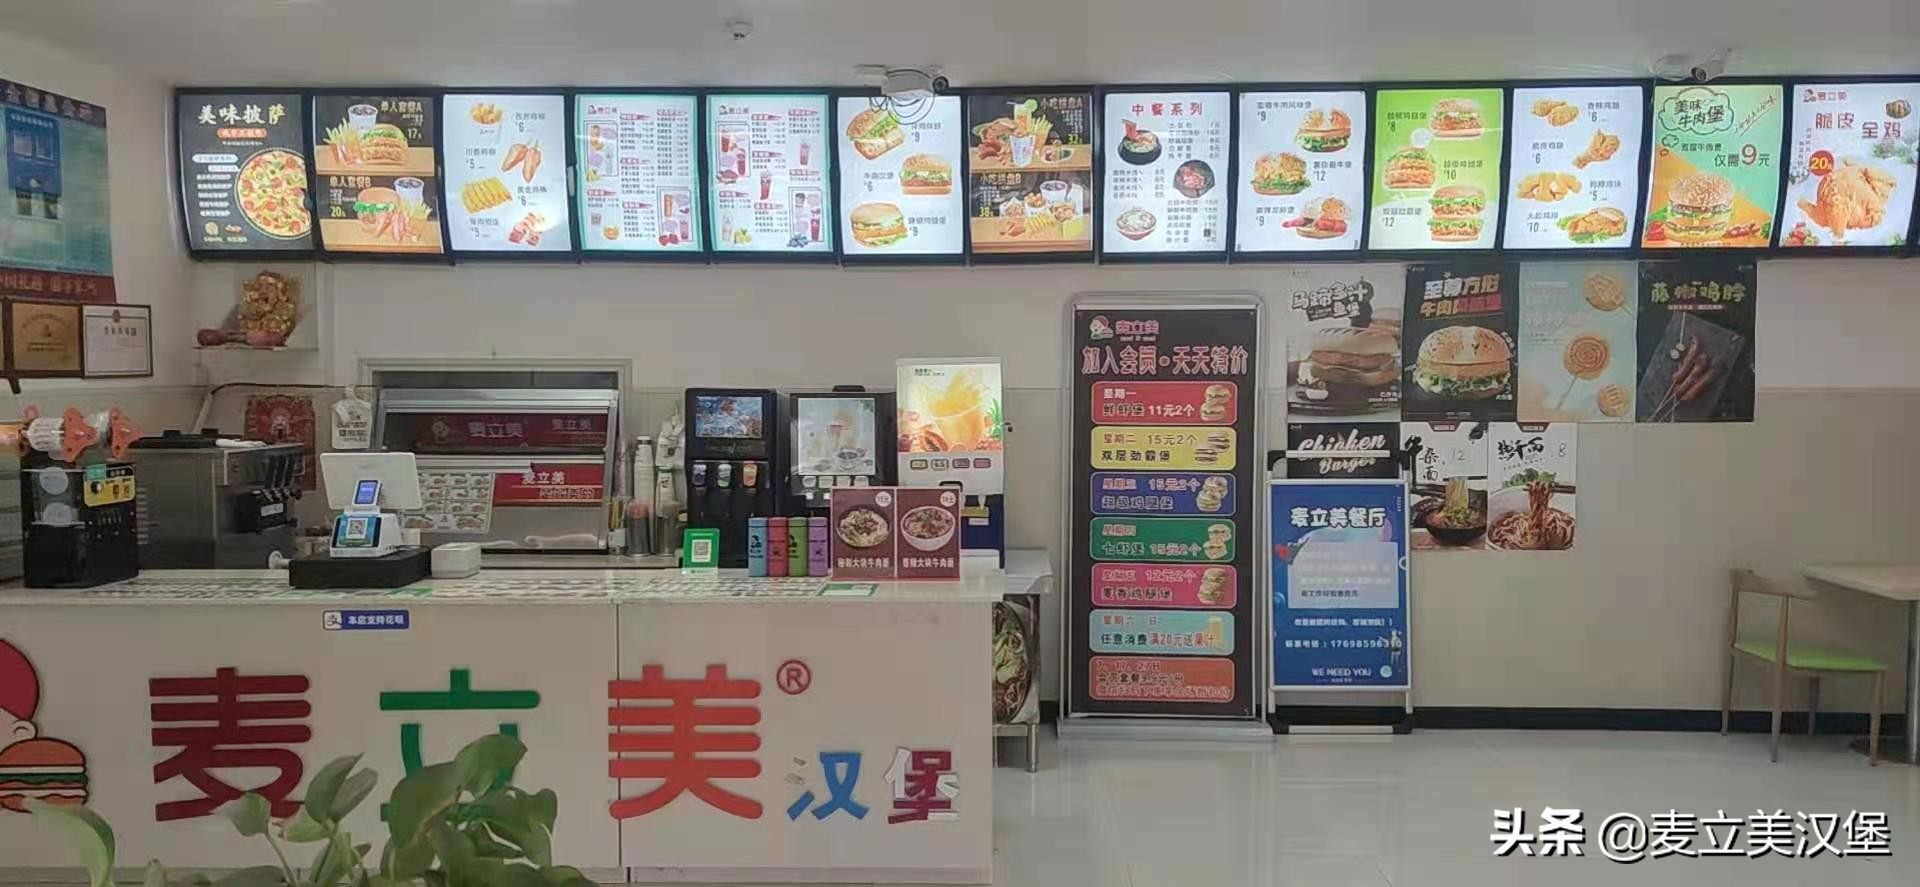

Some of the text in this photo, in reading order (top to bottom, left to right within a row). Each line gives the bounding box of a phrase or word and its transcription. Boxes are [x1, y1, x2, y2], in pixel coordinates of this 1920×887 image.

[1132, 102, 1203, 116] 中餐系列
[1674, 100, 1702, 115] 美味
[1679, 105, 1724, 128] 牛肉堡
[1816, 113, 1855, 129] 脆皮
[1862, 122, 1901, 138] 全鸡
[1715, 144, 1770, 167] 仅需9元
[1103, 388, 1137, 400] 星期一
[1147, 404, 1195, 417] 11元2个
[1103, 433, 1198, 446] 星期二 15元2个
[1297, 427, 1385, 461] Chicken
[1319, 457, 1375, 475] Burger
[1290, 506, 1386, 528] 麦立美餐厅
[1101, 633, 1148, 646] 任意消费
[1312, 667, 1372, 677] WE NEED YOU
